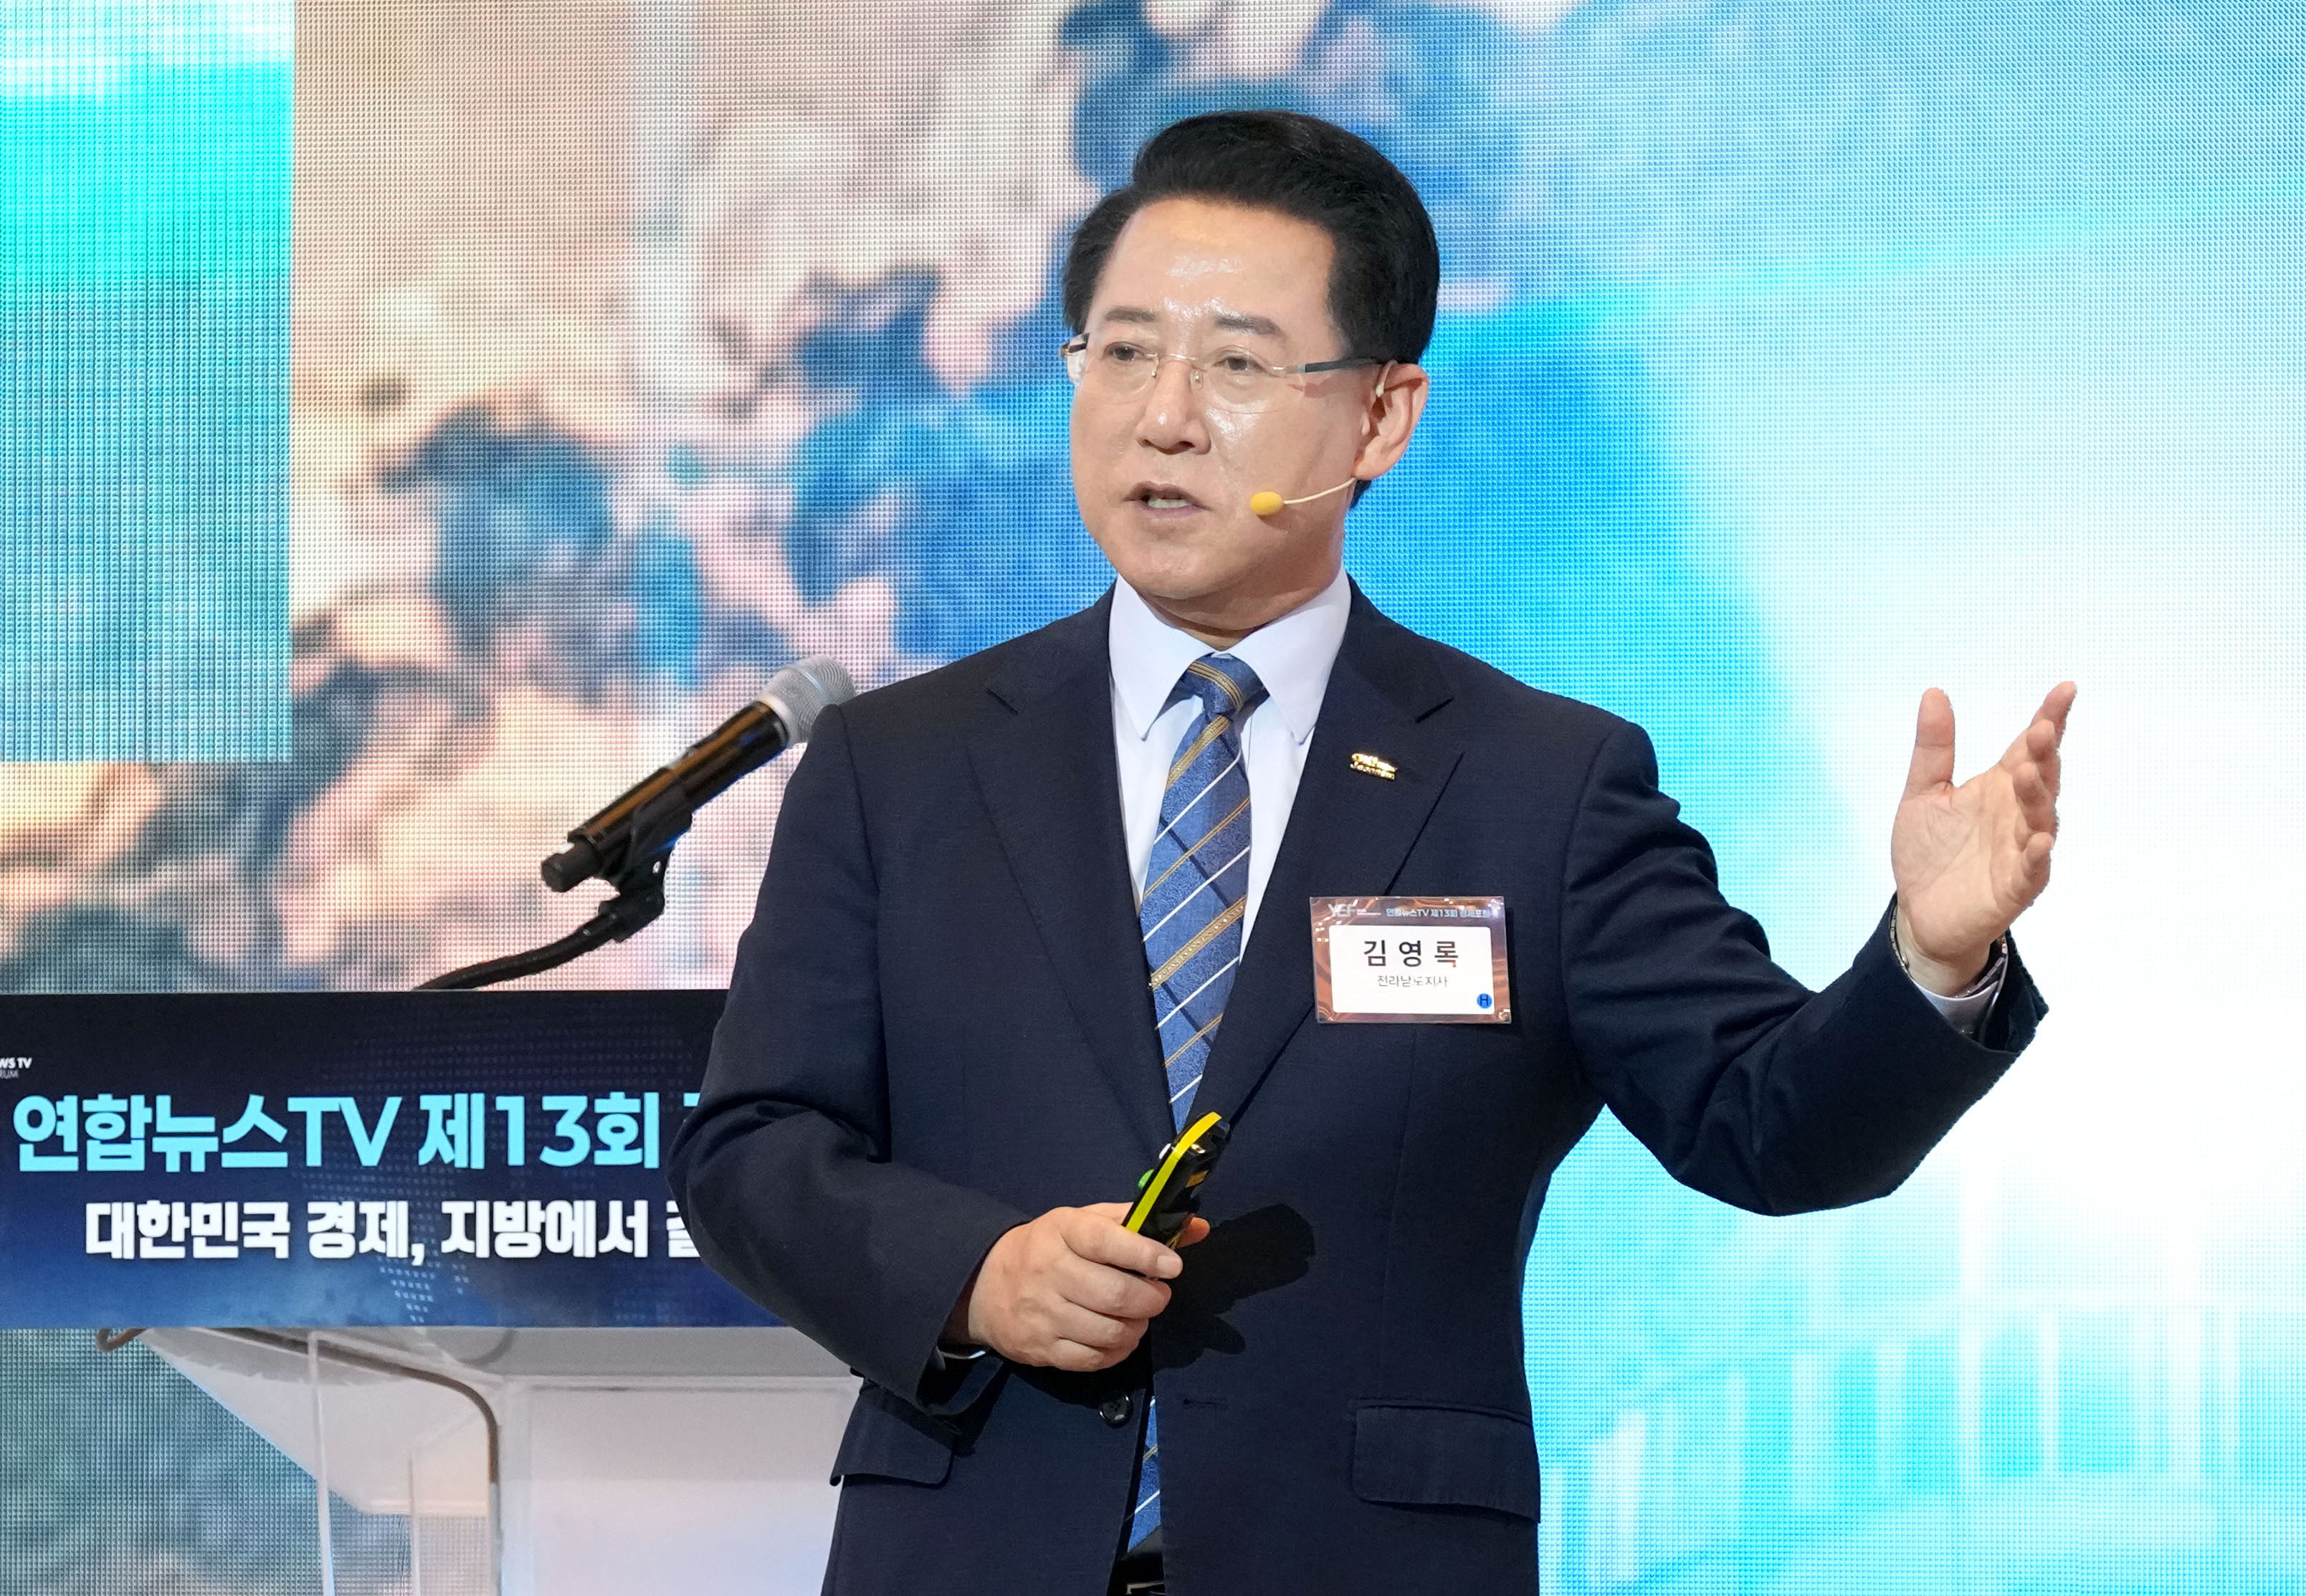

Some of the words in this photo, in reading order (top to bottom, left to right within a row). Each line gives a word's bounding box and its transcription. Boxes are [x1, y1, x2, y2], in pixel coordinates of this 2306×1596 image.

[16, 1057, 32, 1069] TV
[13, 1094, 402, 1172] 연합뉴스TV
[419, 1091, 659, 1170] 제13회
[85, 1200, 290, 1259] 대한민국
[307, 1200, 425, 1266] 경제,
[441, 1200, 648, 1258] 지방에서
